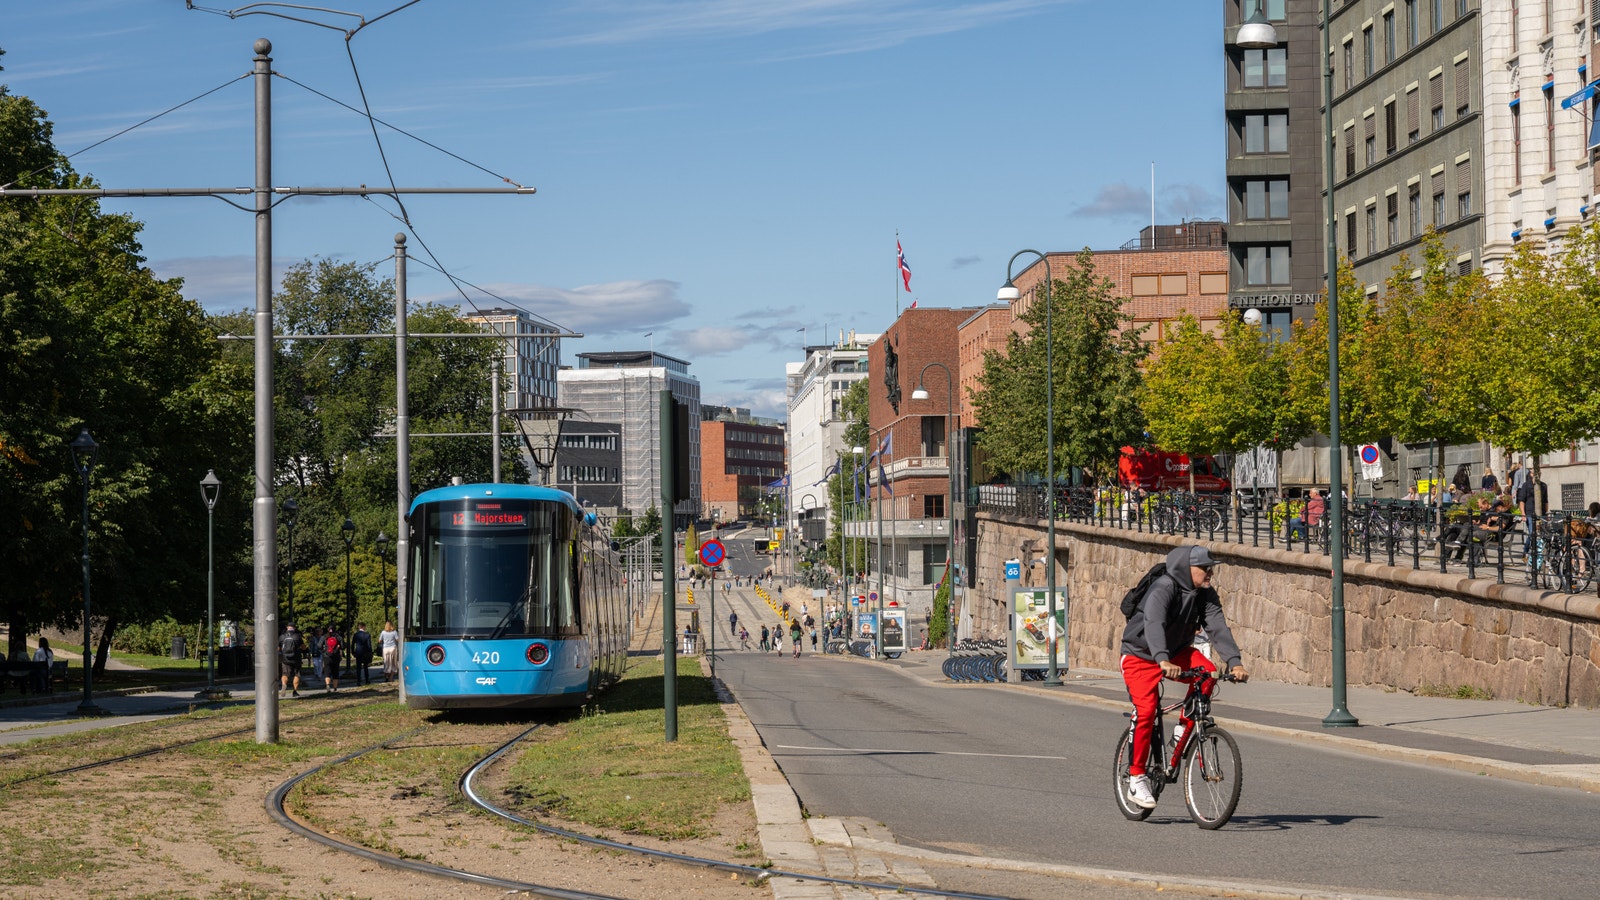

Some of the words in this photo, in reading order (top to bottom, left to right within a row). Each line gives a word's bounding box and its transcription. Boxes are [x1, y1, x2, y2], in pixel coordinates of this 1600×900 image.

[453, 513, 465, 525] 12
[475, 513, 523, 526] Majorstuen
[472, 651, 500, 664] 420
[475, 677, 497, 686] CAF
